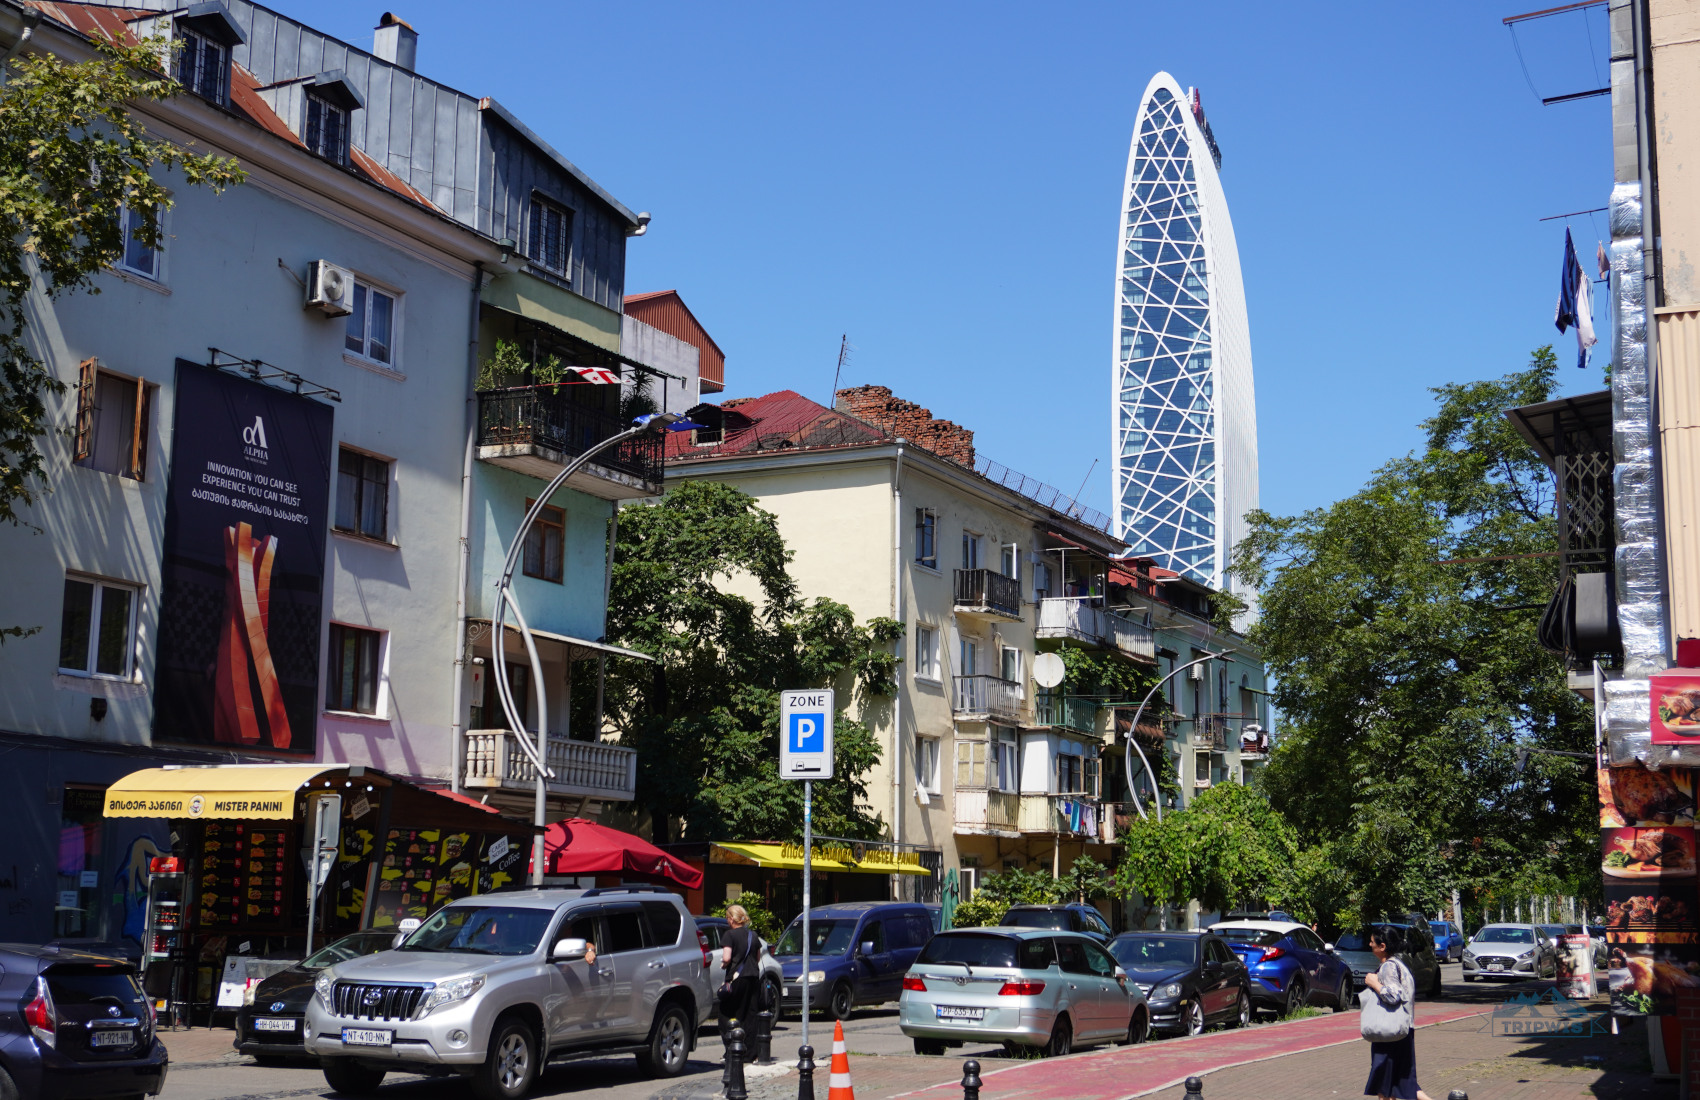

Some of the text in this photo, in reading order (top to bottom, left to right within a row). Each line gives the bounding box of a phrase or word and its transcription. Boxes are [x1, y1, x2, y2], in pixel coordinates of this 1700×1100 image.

[243, 446, 268, 460] ALPHA
[207, 461, 252, 481] INNOVATION
[253, 473, 268, 486] YOU
[270, 478, 283, 490] CAN
[285, 482, 298, 493] SEE
[191, 487, 230, 505] ბათუმის
[202, 473, 301, 507] EXPERIENCE YOU CAN TRUST
[790, 695, 825, 707] ZONE
[797, 718, 816, 748] P
[109, 800, 146, 811] მისტერ
[148, 800, 183, 811] პანინი
[214, 801, 283, 812] MISTER PANINI
[491, 839, 506, 853] CARTE
[492, 847, 506, 858] NOIRE
[498, 852, 521, 871] Coffee
[866, 849, 920, 866] MISTER PANINI
[943, 1006, 977, 1016] PP-635-XX
[97, 1032, 129, 1044] NT-921-NN
[347, 1031, 385, 1042] NT-410-NN
